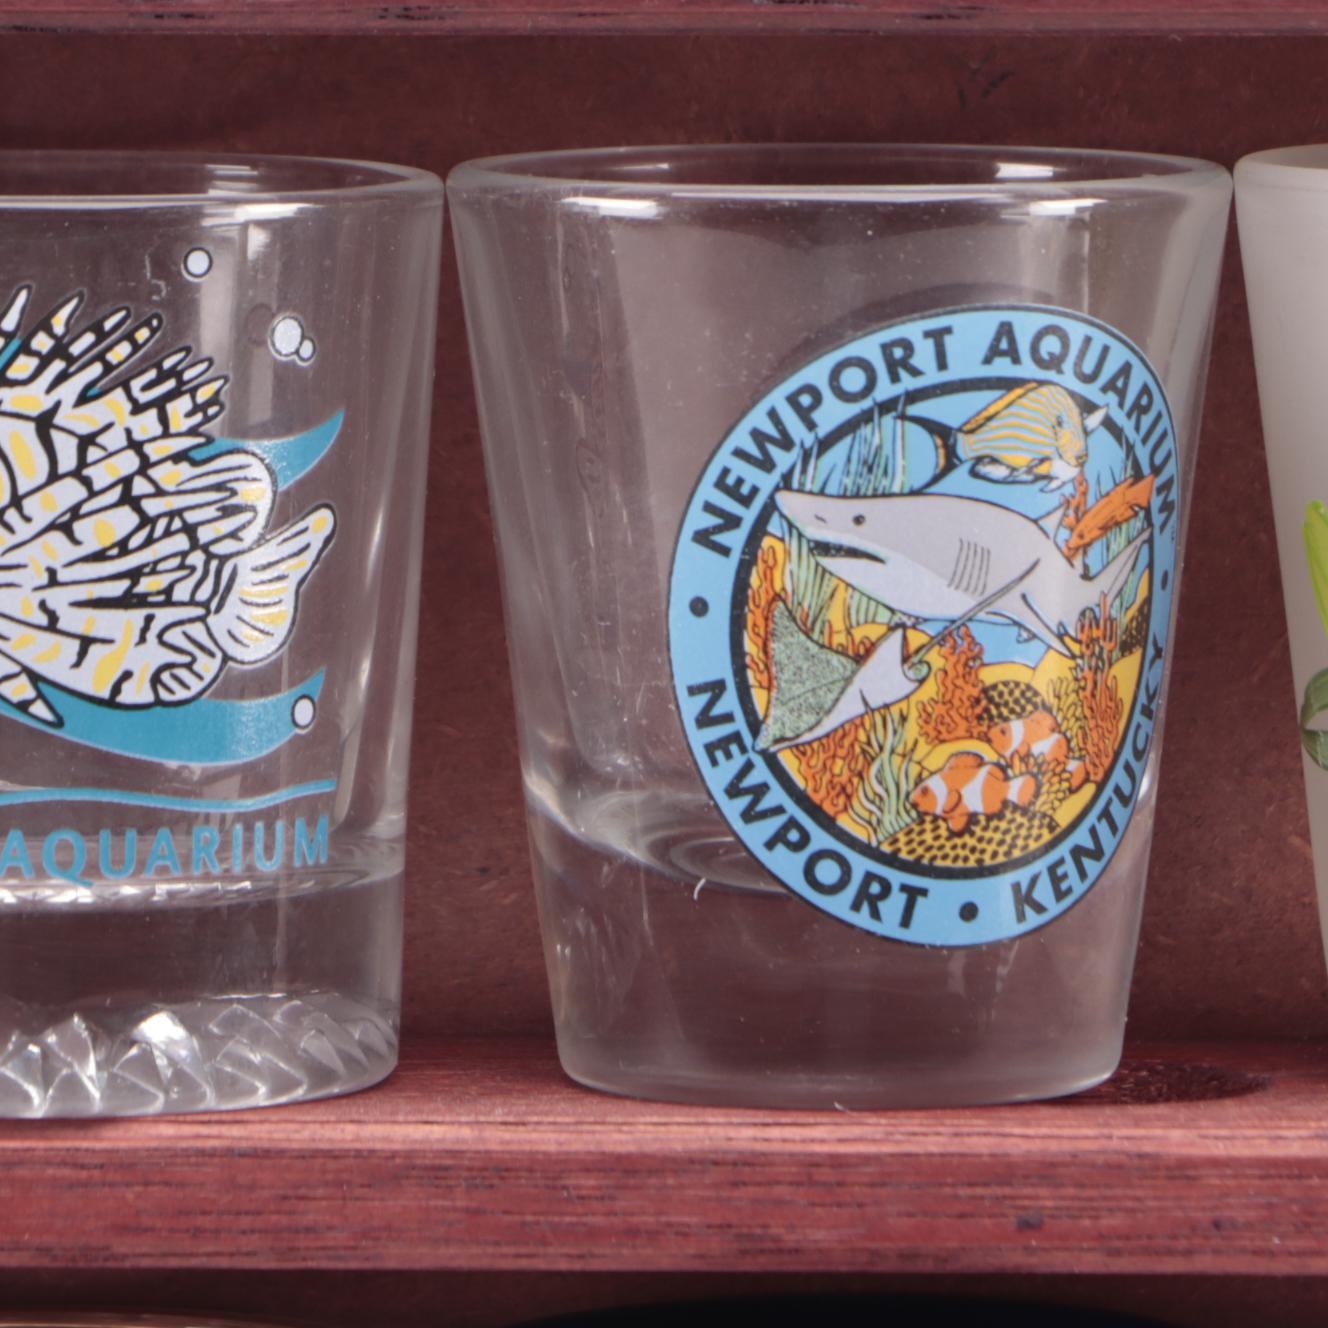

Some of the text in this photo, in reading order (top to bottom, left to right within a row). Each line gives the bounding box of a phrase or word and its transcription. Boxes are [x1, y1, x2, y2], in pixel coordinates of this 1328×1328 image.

[691, 320, 1176, 559] NEWPORT AQUARIUM
[687, 631, 1165, 930] NEWPORT KENTUCKY
